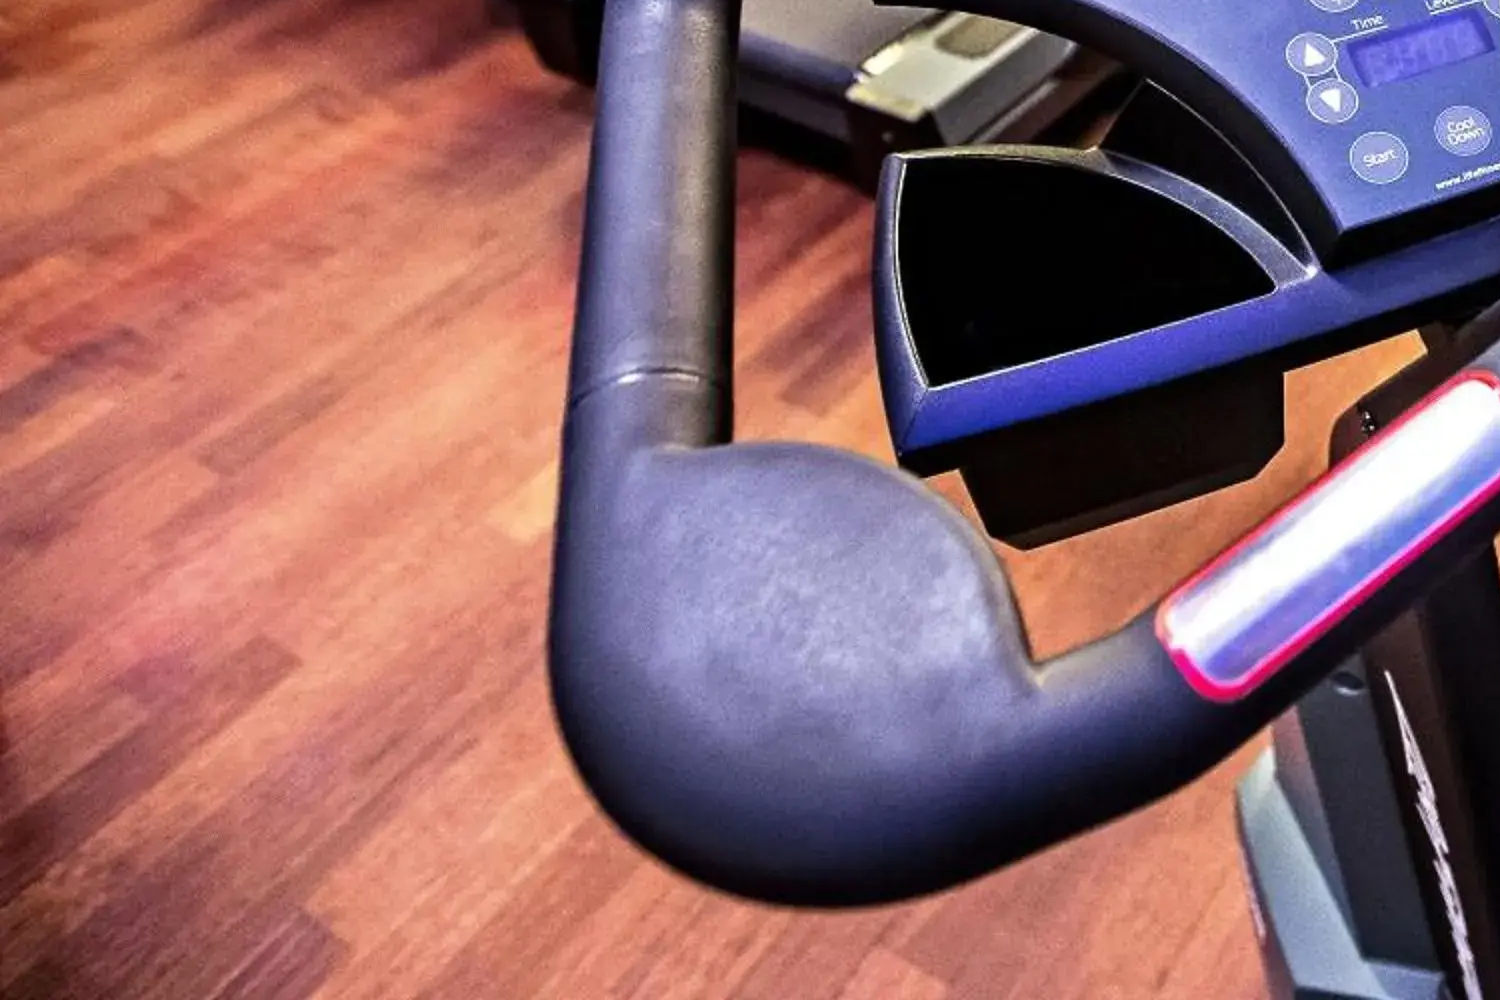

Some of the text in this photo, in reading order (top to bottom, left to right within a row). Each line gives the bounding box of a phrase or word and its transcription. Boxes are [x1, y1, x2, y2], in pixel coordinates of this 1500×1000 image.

[1352, 14, 1384, 31] Time
[1448, 116, 1475, 133] Cool
[1447, 128, 1486, 146] Down
[1363, 149, 1398, 167] Start
